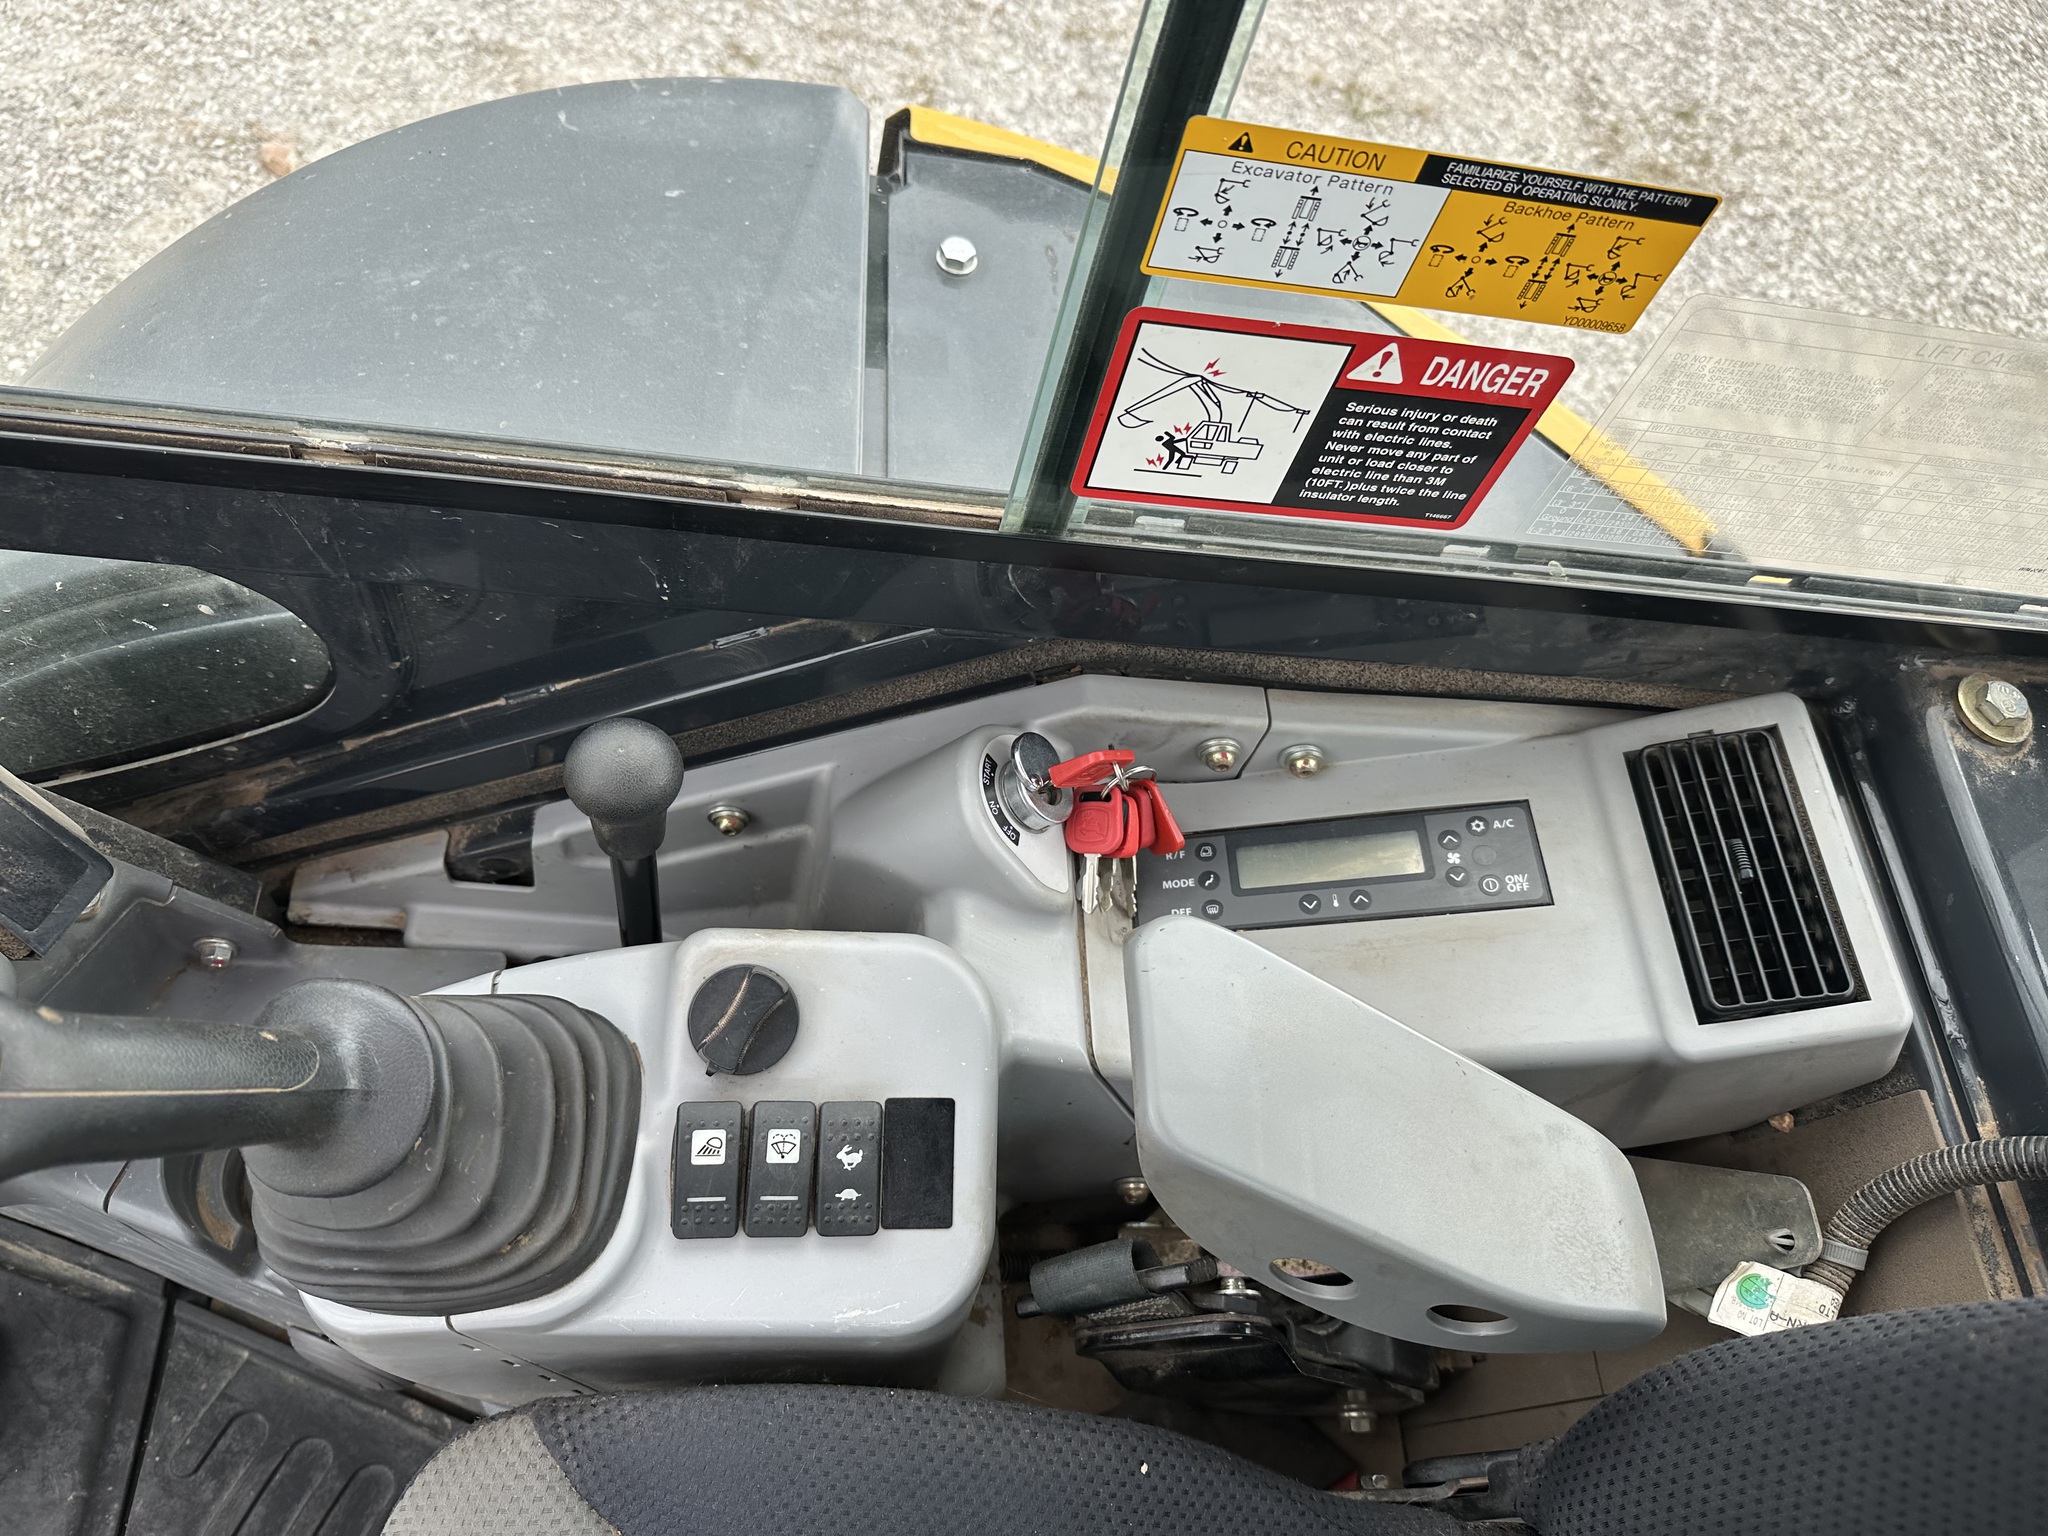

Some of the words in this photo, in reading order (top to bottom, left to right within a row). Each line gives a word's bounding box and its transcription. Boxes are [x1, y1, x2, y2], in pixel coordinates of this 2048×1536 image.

[1286, 141, 1386, 171] CAUTION
[1232, 161, 1322, 184] Excavator
[1327, 175, 1394, 195] Pattern
[1447, 162, 1524, 182] FAMILIARIZE
[1522, 173, 1583, 189] YOURSELF
[1583, 182, 1613, 194] WITH
[1616, 187, 1638, 200] THE
[1638, 191, 1691, 208] PATTERN
[1441, 174, 1503, 191] SELECTED
[1503, 183, 1521, 195] BY
[1522, 185, 1588, 204] OPERATING
[1589, 196, 1638, 212] SLOWLY.
[1503, 201, 1572, 222] Backhoe
[1575, 212, 1635, 231] Pattern
[1562, 315, 1627, 333] YD00009658
[1916, 342, 1969, 361] LIFT
[1419, 356, 1550, 398] DANGER
[1673, 352, 1690, 362] DO
[1691, 354, 1713, 365] NOT
[1714, 357, 1758, 369] ATTEMPT
[1762, 363, 1775, 372] TO
[1777, 365, 1799, 374] LIFT
[1800, 368, 1814, 377] OR
[1816, 371, 1844, 381] HOLD
[1845, 374, 1866, 383] ANY
[1867, 377, 1894, 387] LOAD
[1695, 364, 1706, 373] IS
[1709, 366, 1754, 378] GREATER
[1756, 371, 1781, 382] THAN
[1784, 375, 1815, 386] THESE
[1818, 379, 1849, 390] RATED
[1851, 382, 1888, 395] VALUES
[1933, 368, 1966, 378] NOTES
[1657, 376, 1675, 385] THE
[1677, 379, 1716, 391] WEIGHT
[1718, 383, 1731, 392] OF
[1732, 385, 1767, 398] SLINGS
[1769, 391, 1790, 400] AND
[1842, 399, 1880, 412] LIFTING
[1677, 371, 1705, 382] THEIR
[1707, 375, 1757, 388] SPECIFIED
[1759, 381, 1786, 391] LOAD
[1815, 387, 1837, 397] AND
[1839, 390, 1874, 402] HEIGHT
[1643, 394, 1671, 403] LOAD
[1673, 396, 1686, 405] TO
[1689, 399, 1741, 412] DETERMINE
[1743, 405, 1762, 414] THE
[1764, 407, 1783, 416] NET
[1785, 410, 1813, 420] LOAD
[1840, 416, 1860, 425] MAY
[1651, 385, 1690, 397] DEVICES
[1692, 391, 1720, 401] MUST
[1722, 394, 1735, 402] BE
[1737, 396, 1788, 409] DEDUCTED
[1790, 402, 1817, 412] FROM
[1818, 406, 1837, 414] THE
[1839, 408, 1870, 419] RATED
[1346, 402, 1398, 416] Serious
[1401, 408, 1440, 423] injury
[1442, 413, 1458, 422] or
[1460, 414, 1498, 427] death
[1332, 429, 1360, 440] with
[1364, 432, 1414, 445] electric
[1418, 437, 1452, 448] lines.
[1338, 417, 1363, 426] can
[1366, 419, 1403, 430] result
[1408, 423, 1439, 434] from
[1442, 427, 1491, 440] contact
[1651, 424, 1675, 433] WITH
[1678, 426, 1710, 437] DOZER
[1711, 430, 1741, 442] BLADE
[1743, 434, 1776, 445] ABOVE
[1777, 438, 1818, 449] GROUND
[1318, 454, 1344, 464] unit
[1348, 458, 1363, 466] or
[1365, 457, 1394, 469] load
[1397, 461, 1437, 473] closer
[1440, 465, 1453, 474] to
[1325, 441, 1364, 453] Never
[1367, 447, 1403, 457] move
[1406, 451, 1431, 462] any
[1432, 453, 1459, 463] part
[1462, 455, 1477, 464] of
[1311, 466, 1361, 478] electric
[1365, 471, 1388, 481] line
[1393, 474, 1422, 484] than
[1425, 476, 1447, 486] 3M
[1628, 458, 1647, 467] Side
[1656, 462, 1680, 471] Front
[1715, 469, 1739, 478] Front
[1774, 476, 1798, 485] Front
[1299, 489, 1355, 502] insulator
[1357, 494, 1400, 506] length.
[1381, 485, 1415, 495] twice
[1419, 488, 1440, 498] the
[1442, 491, 1467, 501] line
[1541, 513, 1575, 523] Ground
[983, 758, 992, 785] START
[989, 801, 998, 815] ON
[1002, 825, 1016, 840] OFF
[1493, 819, 1514, 829] A/C
[1166, 851, 1185, 860] R/F
[1162, 878, 1195, 889] MODE
[1505, 874, 1528, 884] ON/
[1507, 882, 1529, 892] OFF
[1748, 1315, 1764, 1328] LOT
